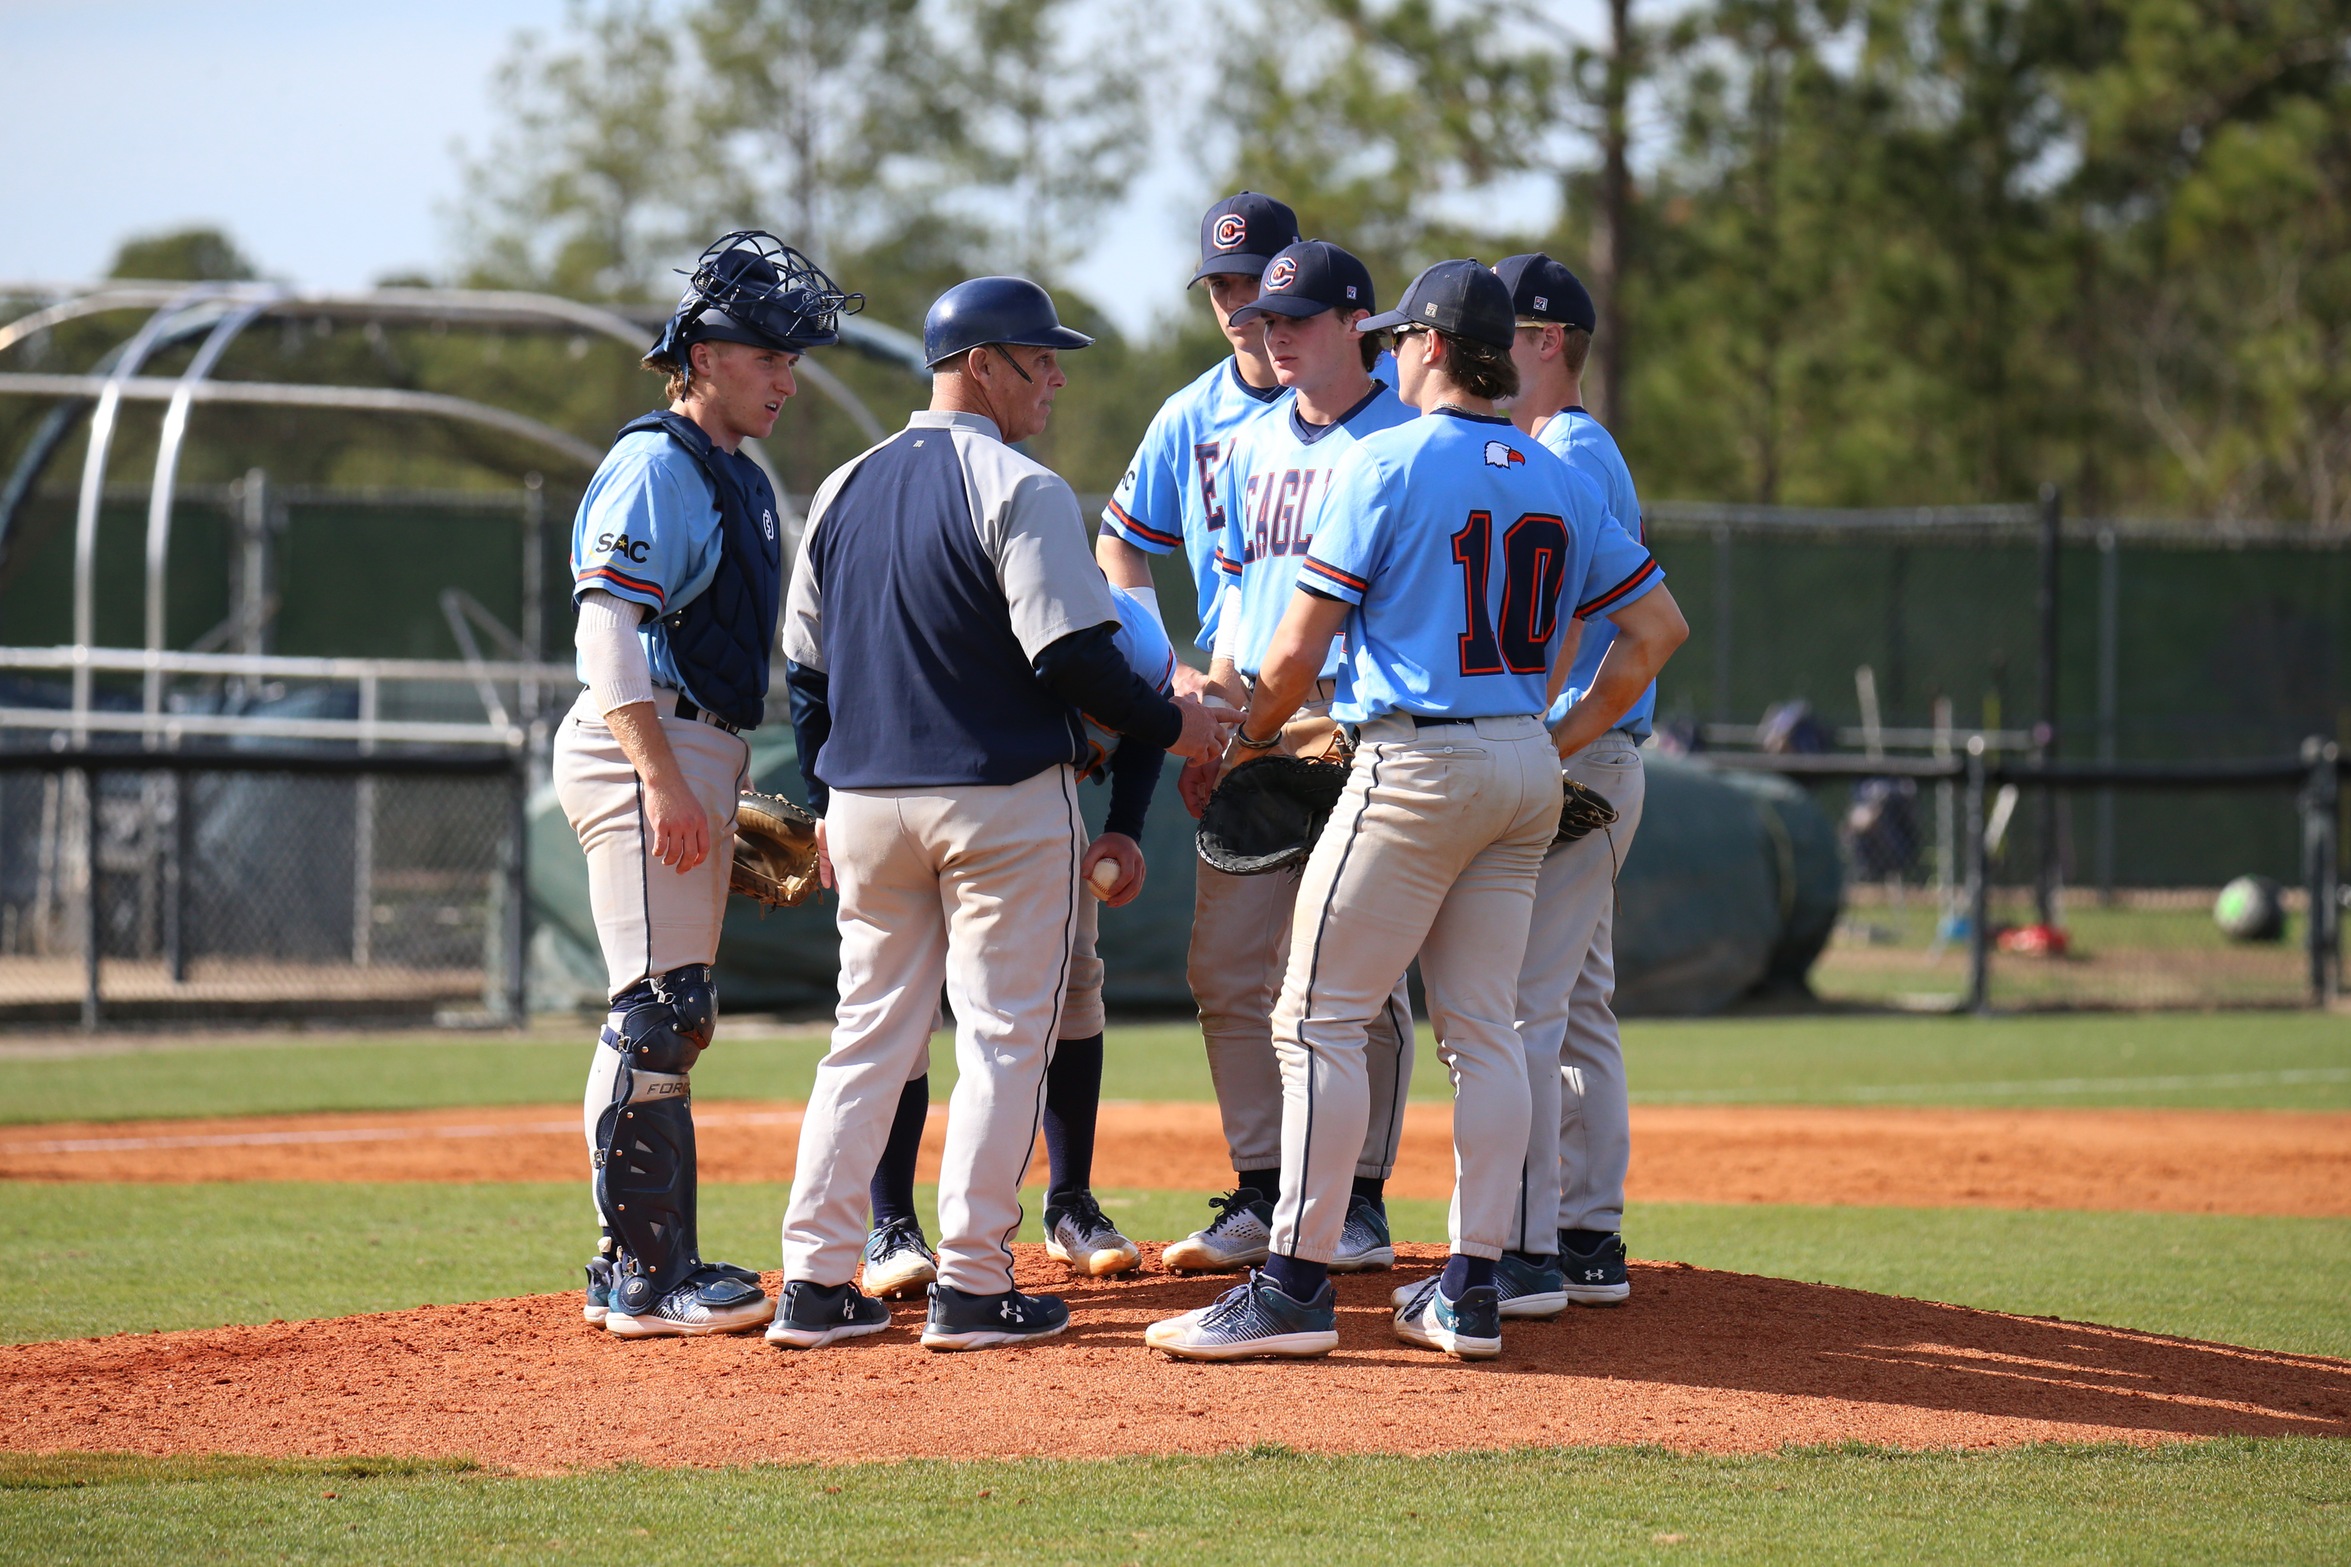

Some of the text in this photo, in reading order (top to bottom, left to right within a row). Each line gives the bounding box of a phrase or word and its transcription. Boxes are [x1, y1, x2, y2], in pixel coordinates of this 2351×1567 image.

[595, 532, 651, 564] SAC
[1242, 468, 1333, 565] EAGL
[1450, 509, 1569, 677] 10
